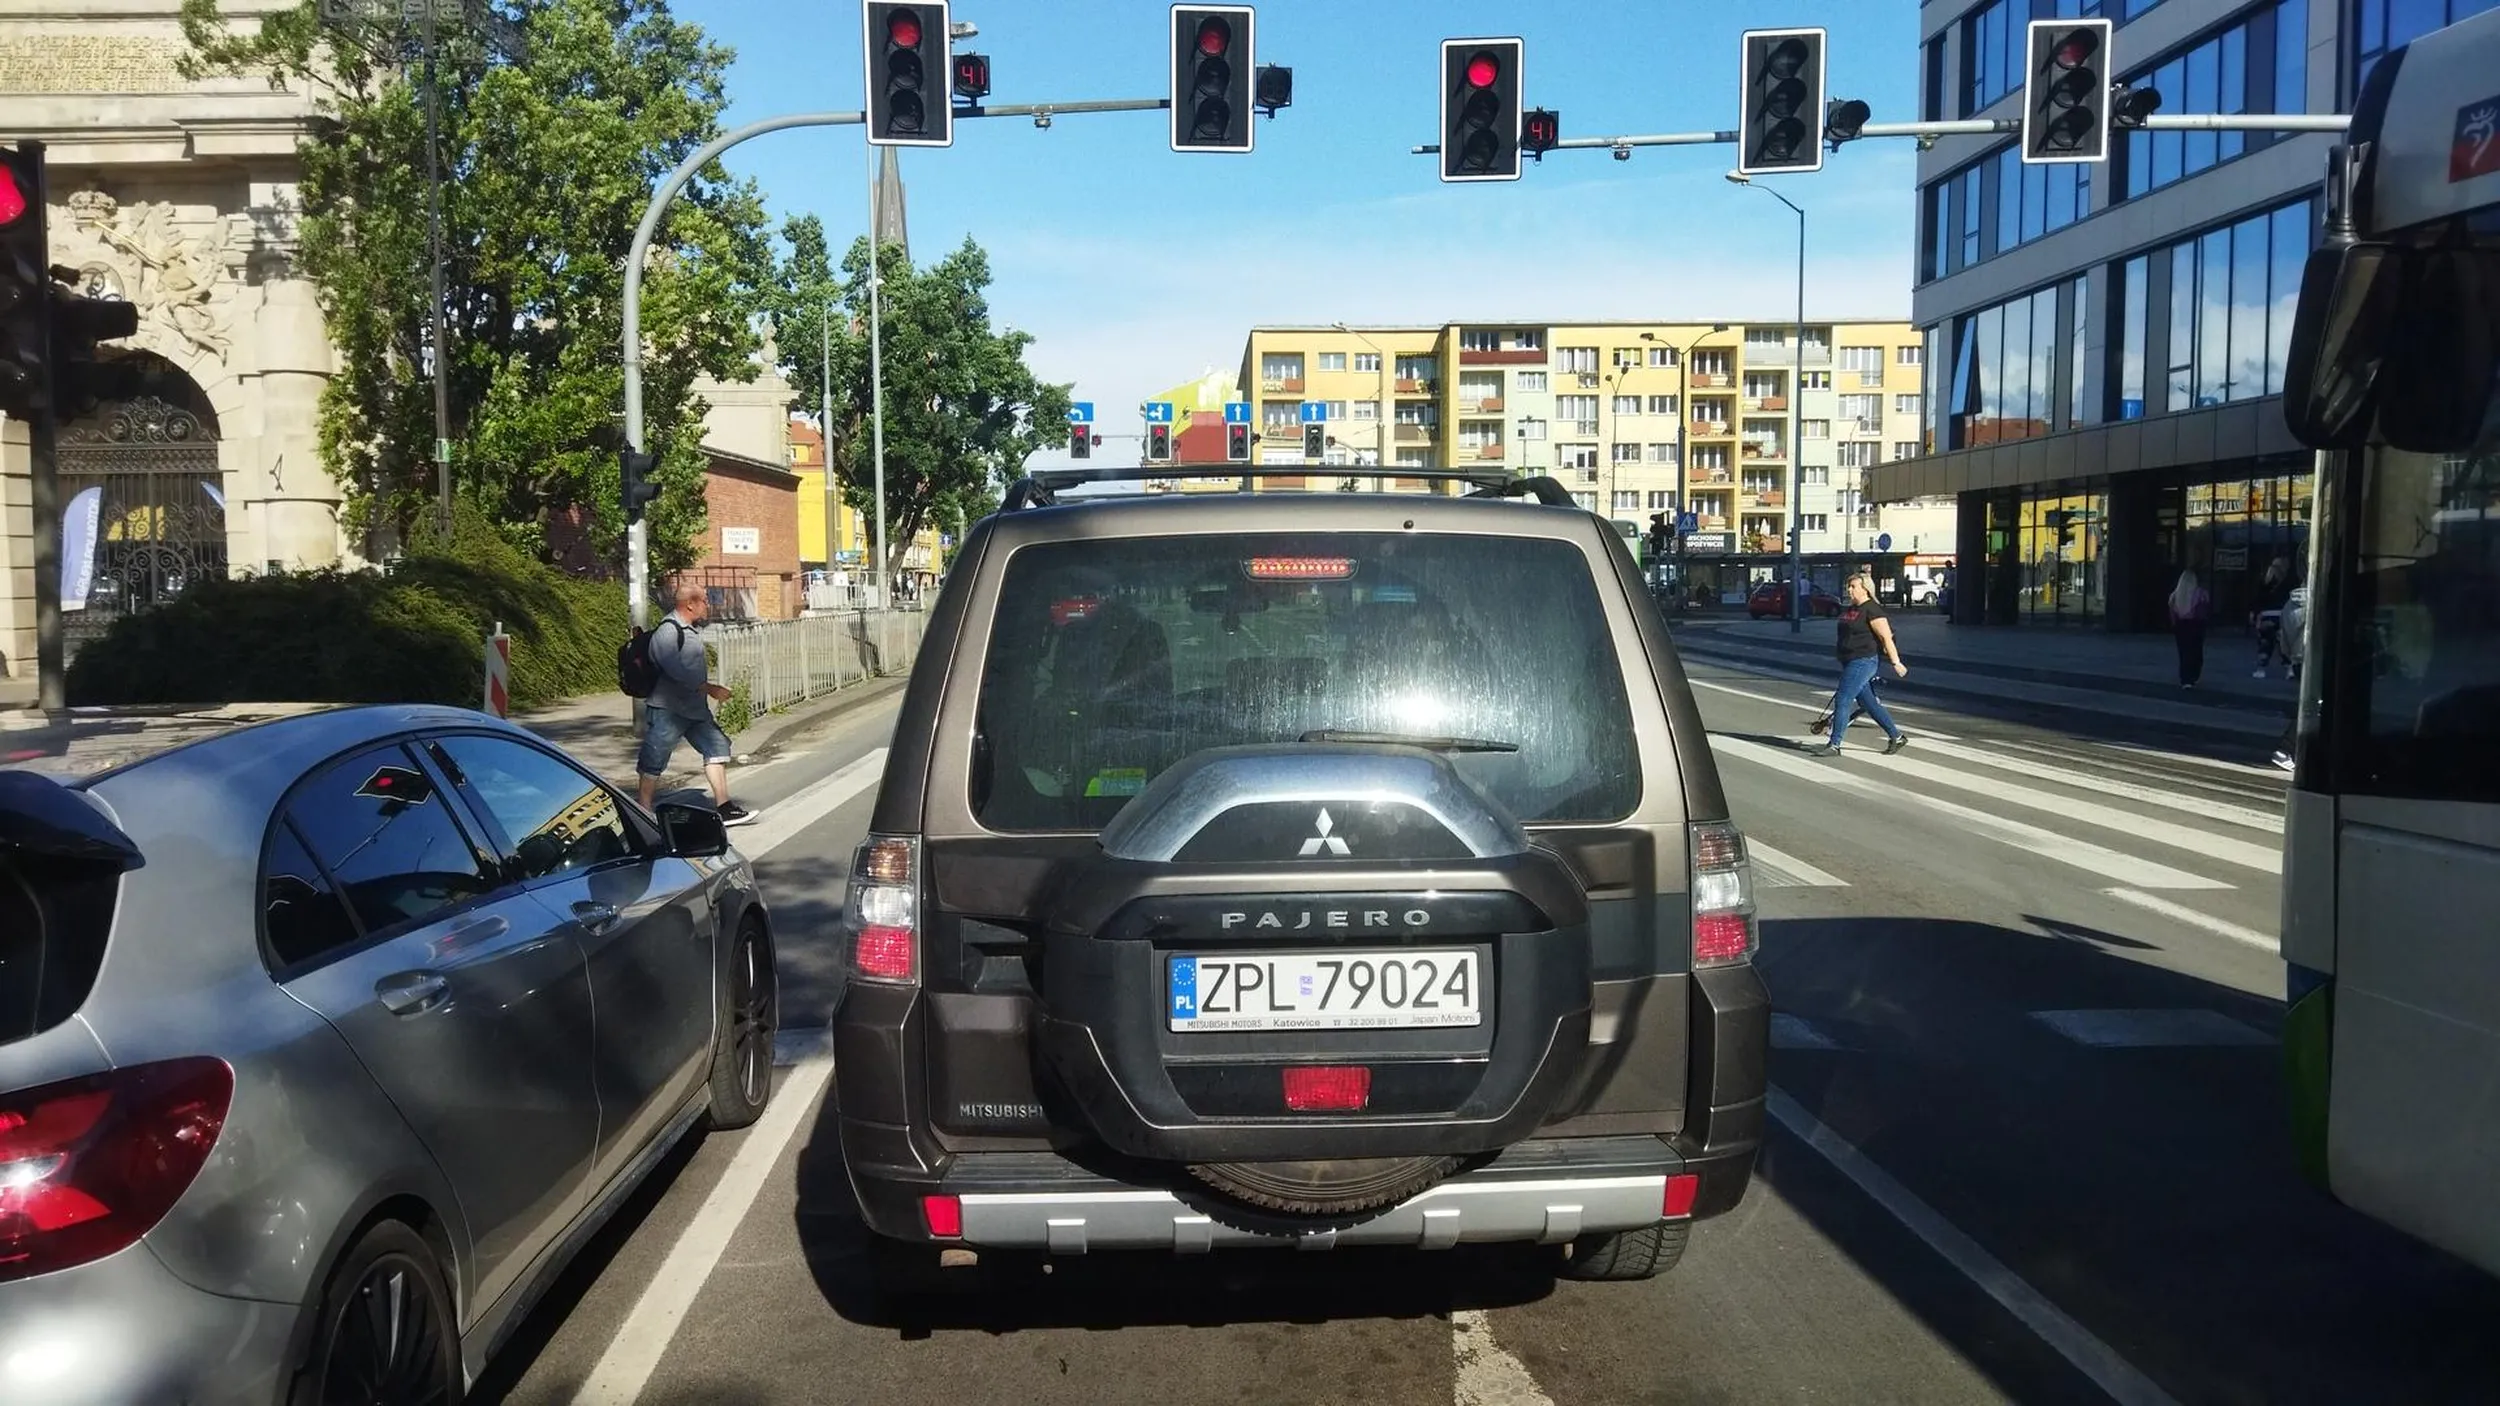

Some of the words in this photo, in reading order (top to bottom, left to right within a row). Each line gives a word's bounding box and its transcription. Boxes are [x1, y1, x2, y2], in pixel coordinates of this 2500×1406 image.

[962, 65, 984, 85] 41
[1531, 121, 1553, 140] 41
[1221, 909, 1431, 929] PAJERO
[1201, 962, 1296, 1012] ZPL
[1316, 958, 1470, 1010] 79024
[1175, 995, 1195, 1010] PL
[1187, 1020, 1229, 1029] MITSUBISHI
[1231, 1019, 1262, 1028] MOTORS
[1273, 1018, 1321, 1027] Katowice
[1410, 1014, 1438, 1024] Japan
[1441, 1013, 1476, 1023] Motors
[960, 1103, 1044, 1118] MITSUBISHI
